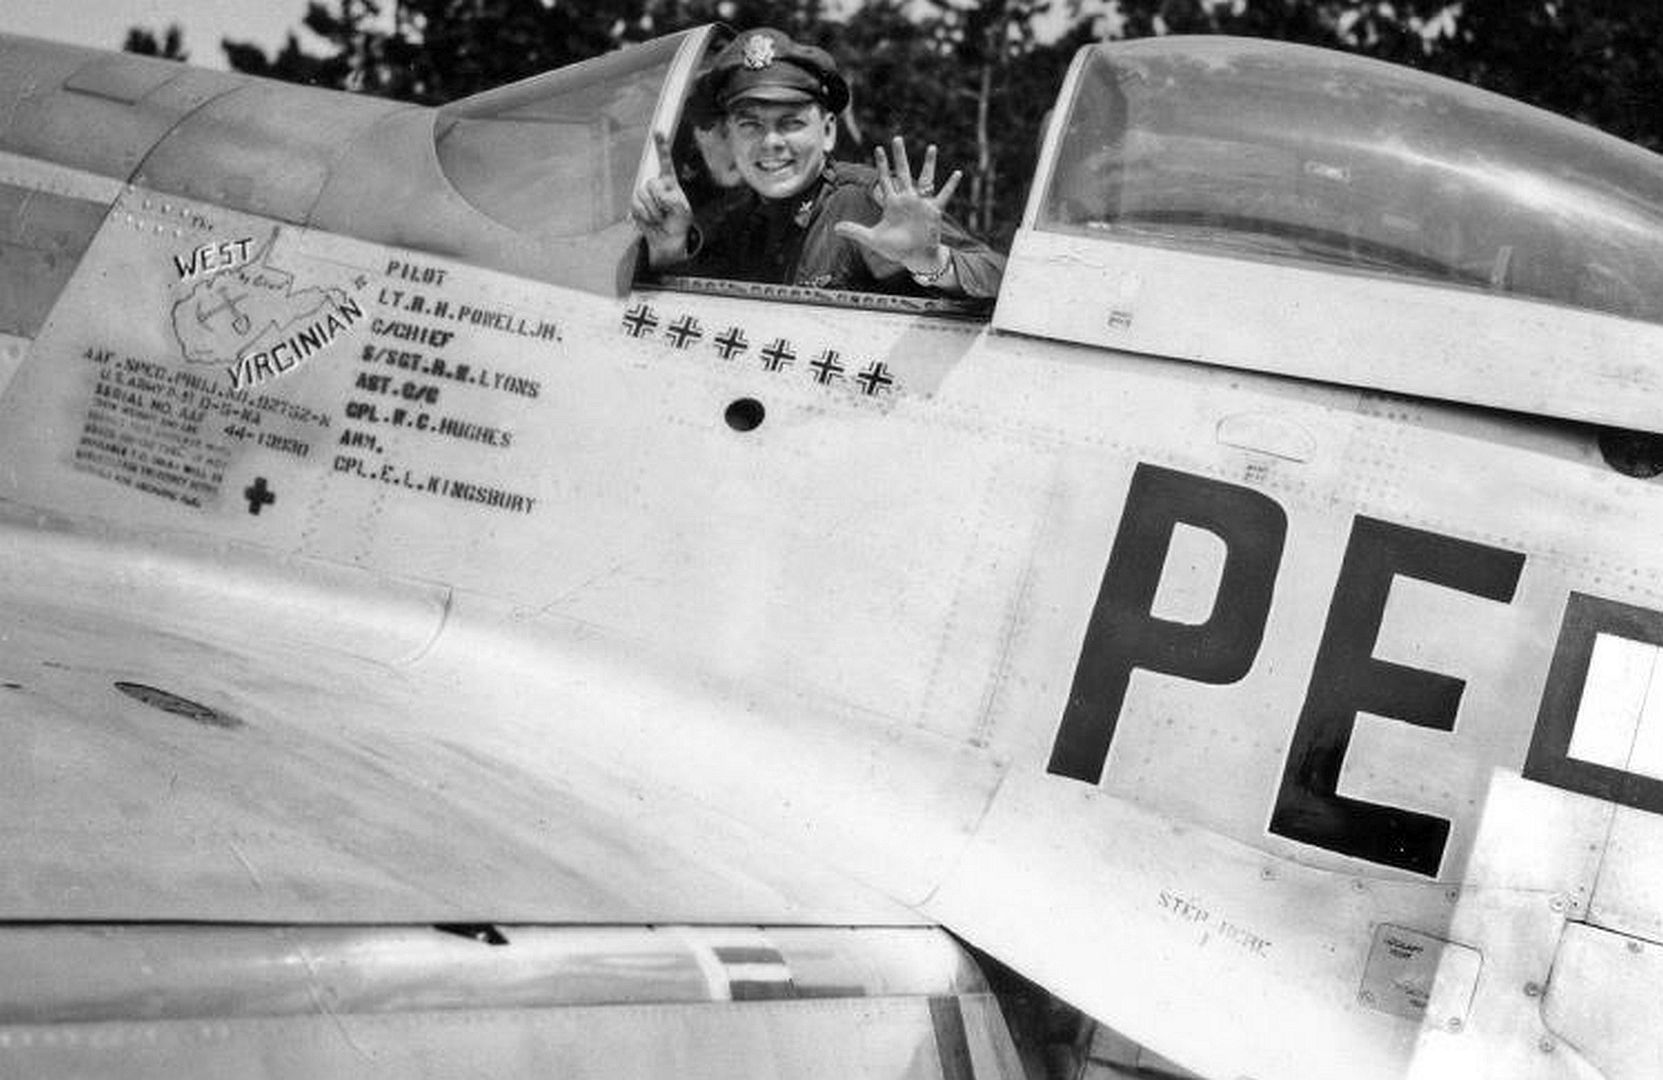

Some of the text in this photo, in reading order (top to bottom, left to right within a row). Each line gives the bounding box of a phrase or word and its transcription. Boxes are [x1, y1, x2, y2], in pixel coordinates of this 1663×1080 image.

[173, 236, 253, 278] WEST
[385, 259, 448, 285] PILOT
[227, 297, 363, 389] VIRGINIAN
